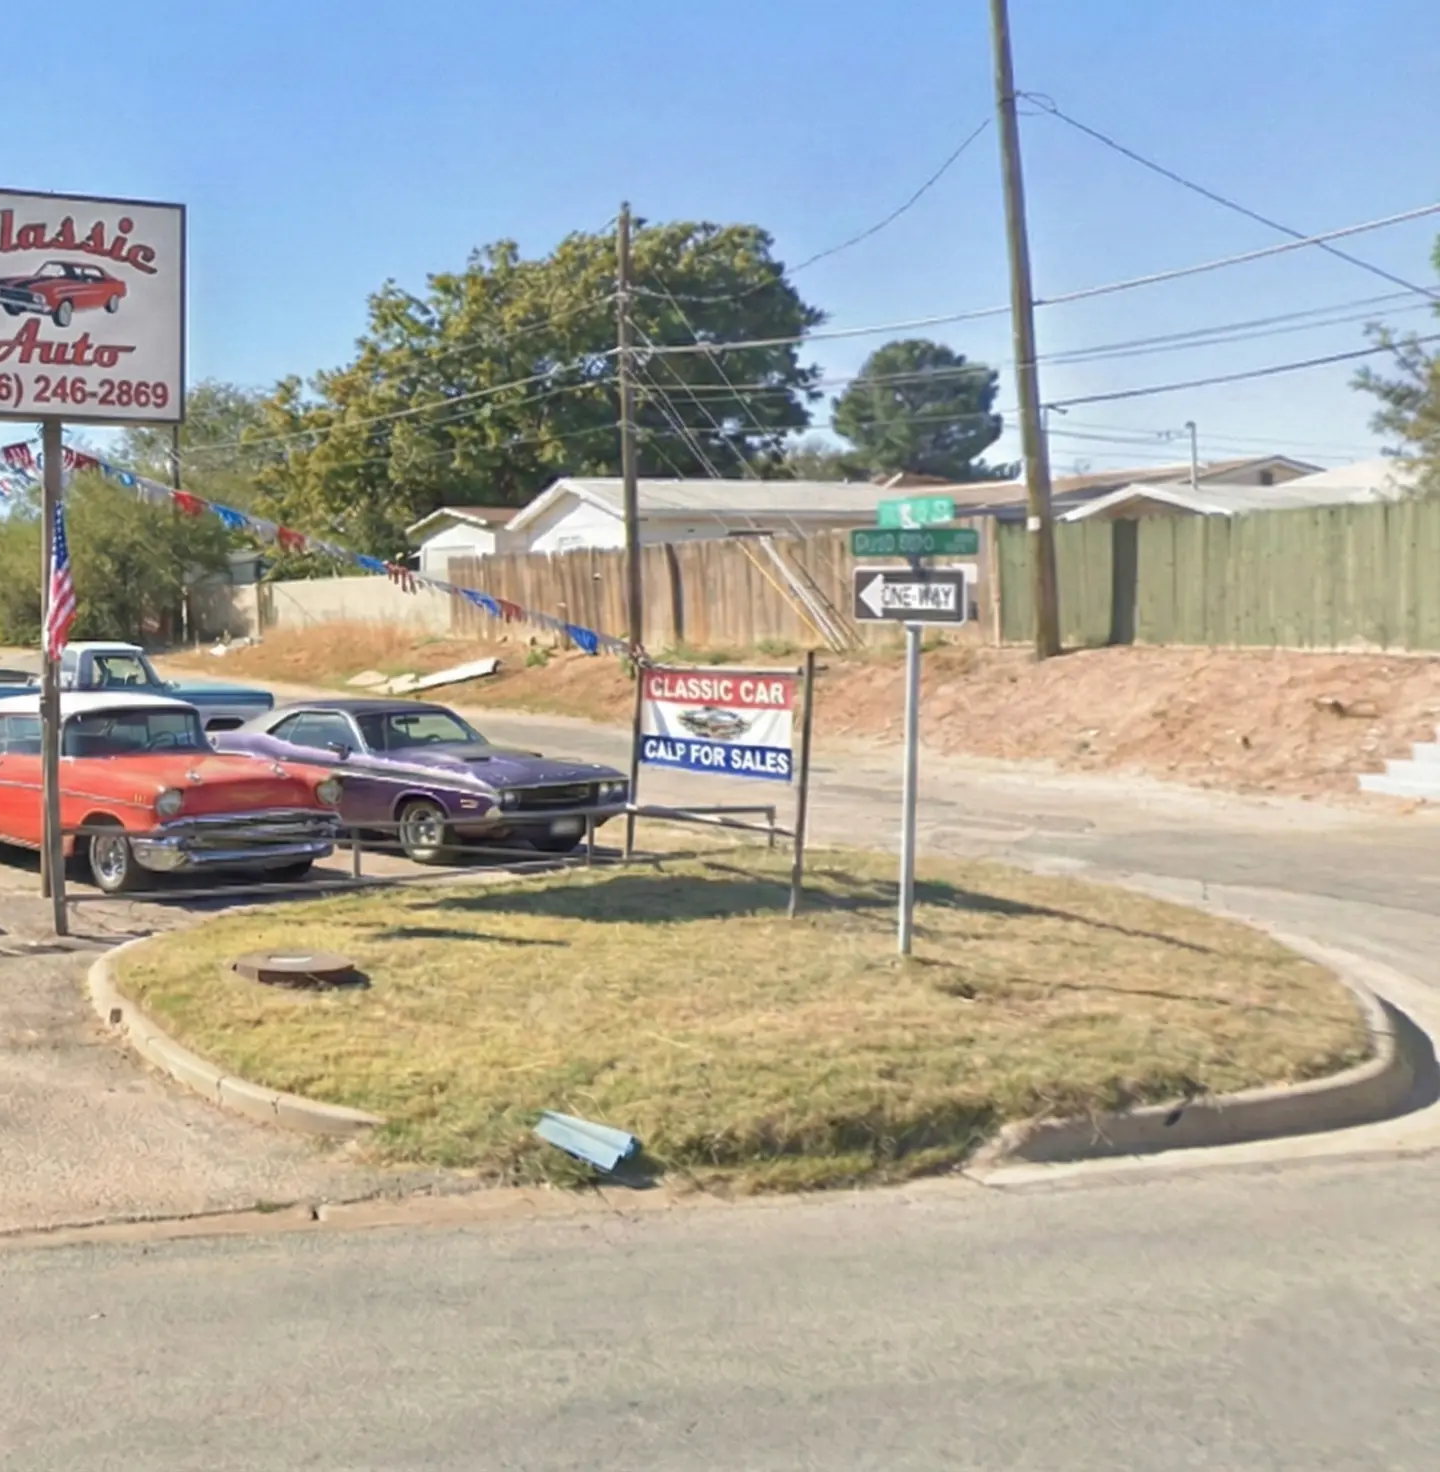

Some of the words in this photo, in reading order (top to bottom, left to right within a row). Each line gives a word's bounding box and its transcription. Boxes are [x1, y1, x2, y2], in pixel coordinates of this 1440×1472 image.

[33, 374, 169, 409] 246-2869
[649, 676, 734, 702] CLASSIC
[739, 680, 786, 705] CAR
[690, 744, 726, 767] FOR
[730, 748, 790, 774] SALES
